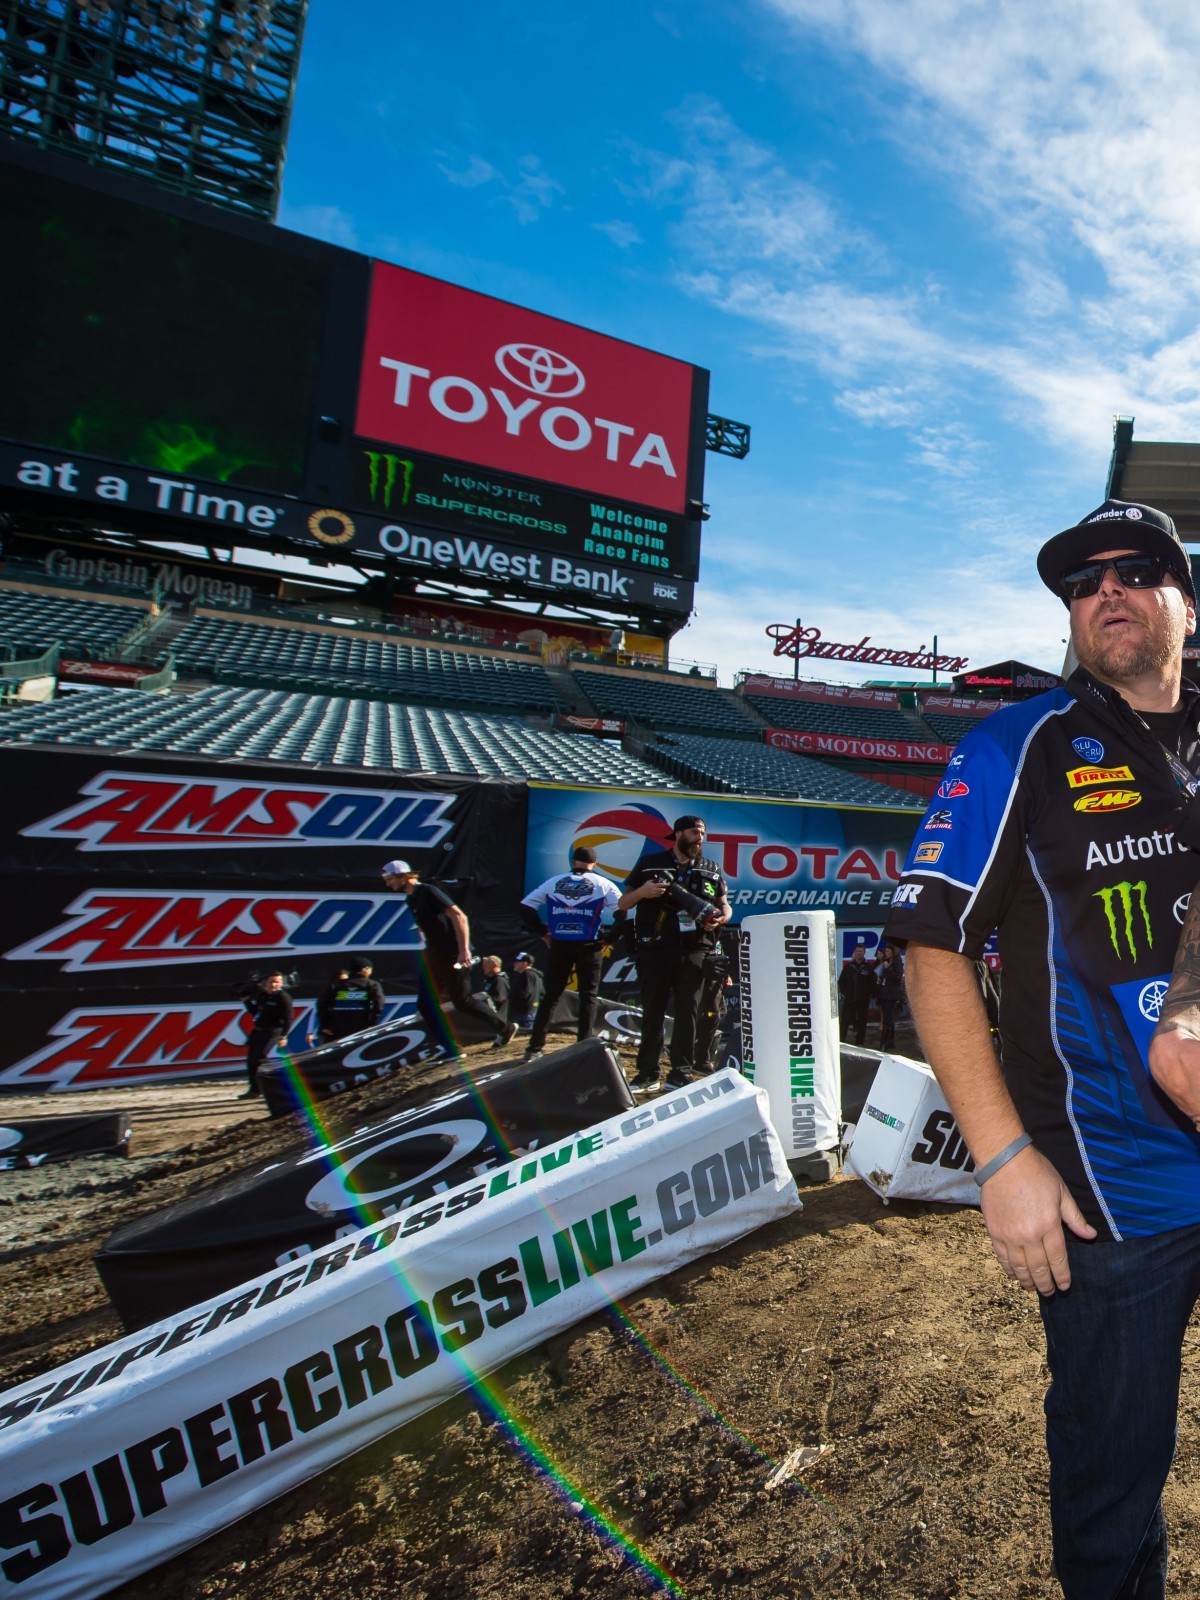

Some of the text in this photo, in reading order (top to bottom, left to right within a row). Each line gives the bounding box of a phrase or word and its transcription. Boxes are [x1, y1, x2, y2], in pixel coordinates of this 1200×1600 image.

[380, 356, 677, 478] TOYOTA
[17, 460, 278, 528] at a Time
[442, 473, 543, 506] MONSTER
[415, 493, 568, 535] SUPERCROSS
[590, 503, 668, 534] Welcome
[591, 521, 665, 550] Anaheim
[45, 549, 149, 587] Captain
[379, 525, 628, 597] OneWest Bank
[584, 539, 670, 569] Race Fans
[654, 588, 678, 600] FDIC
[765, 623, 969, 673] Budweiser
[1016, 673, 1057, 688] PATIO
[770, 733, 812, 750] CNC
[906, 746, 943, 760] INC.
[1073, 769, 1128, 784] PIRELLI
[46, 775, 454, 849] AMSOIL
[1075, 791, 1140, 811] FMF
[727, 889, 872, 906] ERFORMANCE
[0, 1077, 736, 1428] SUPERCROSSLIVE.COM
[0, 1130, 776, 1584] SUPERCROSSLIVE.COM
